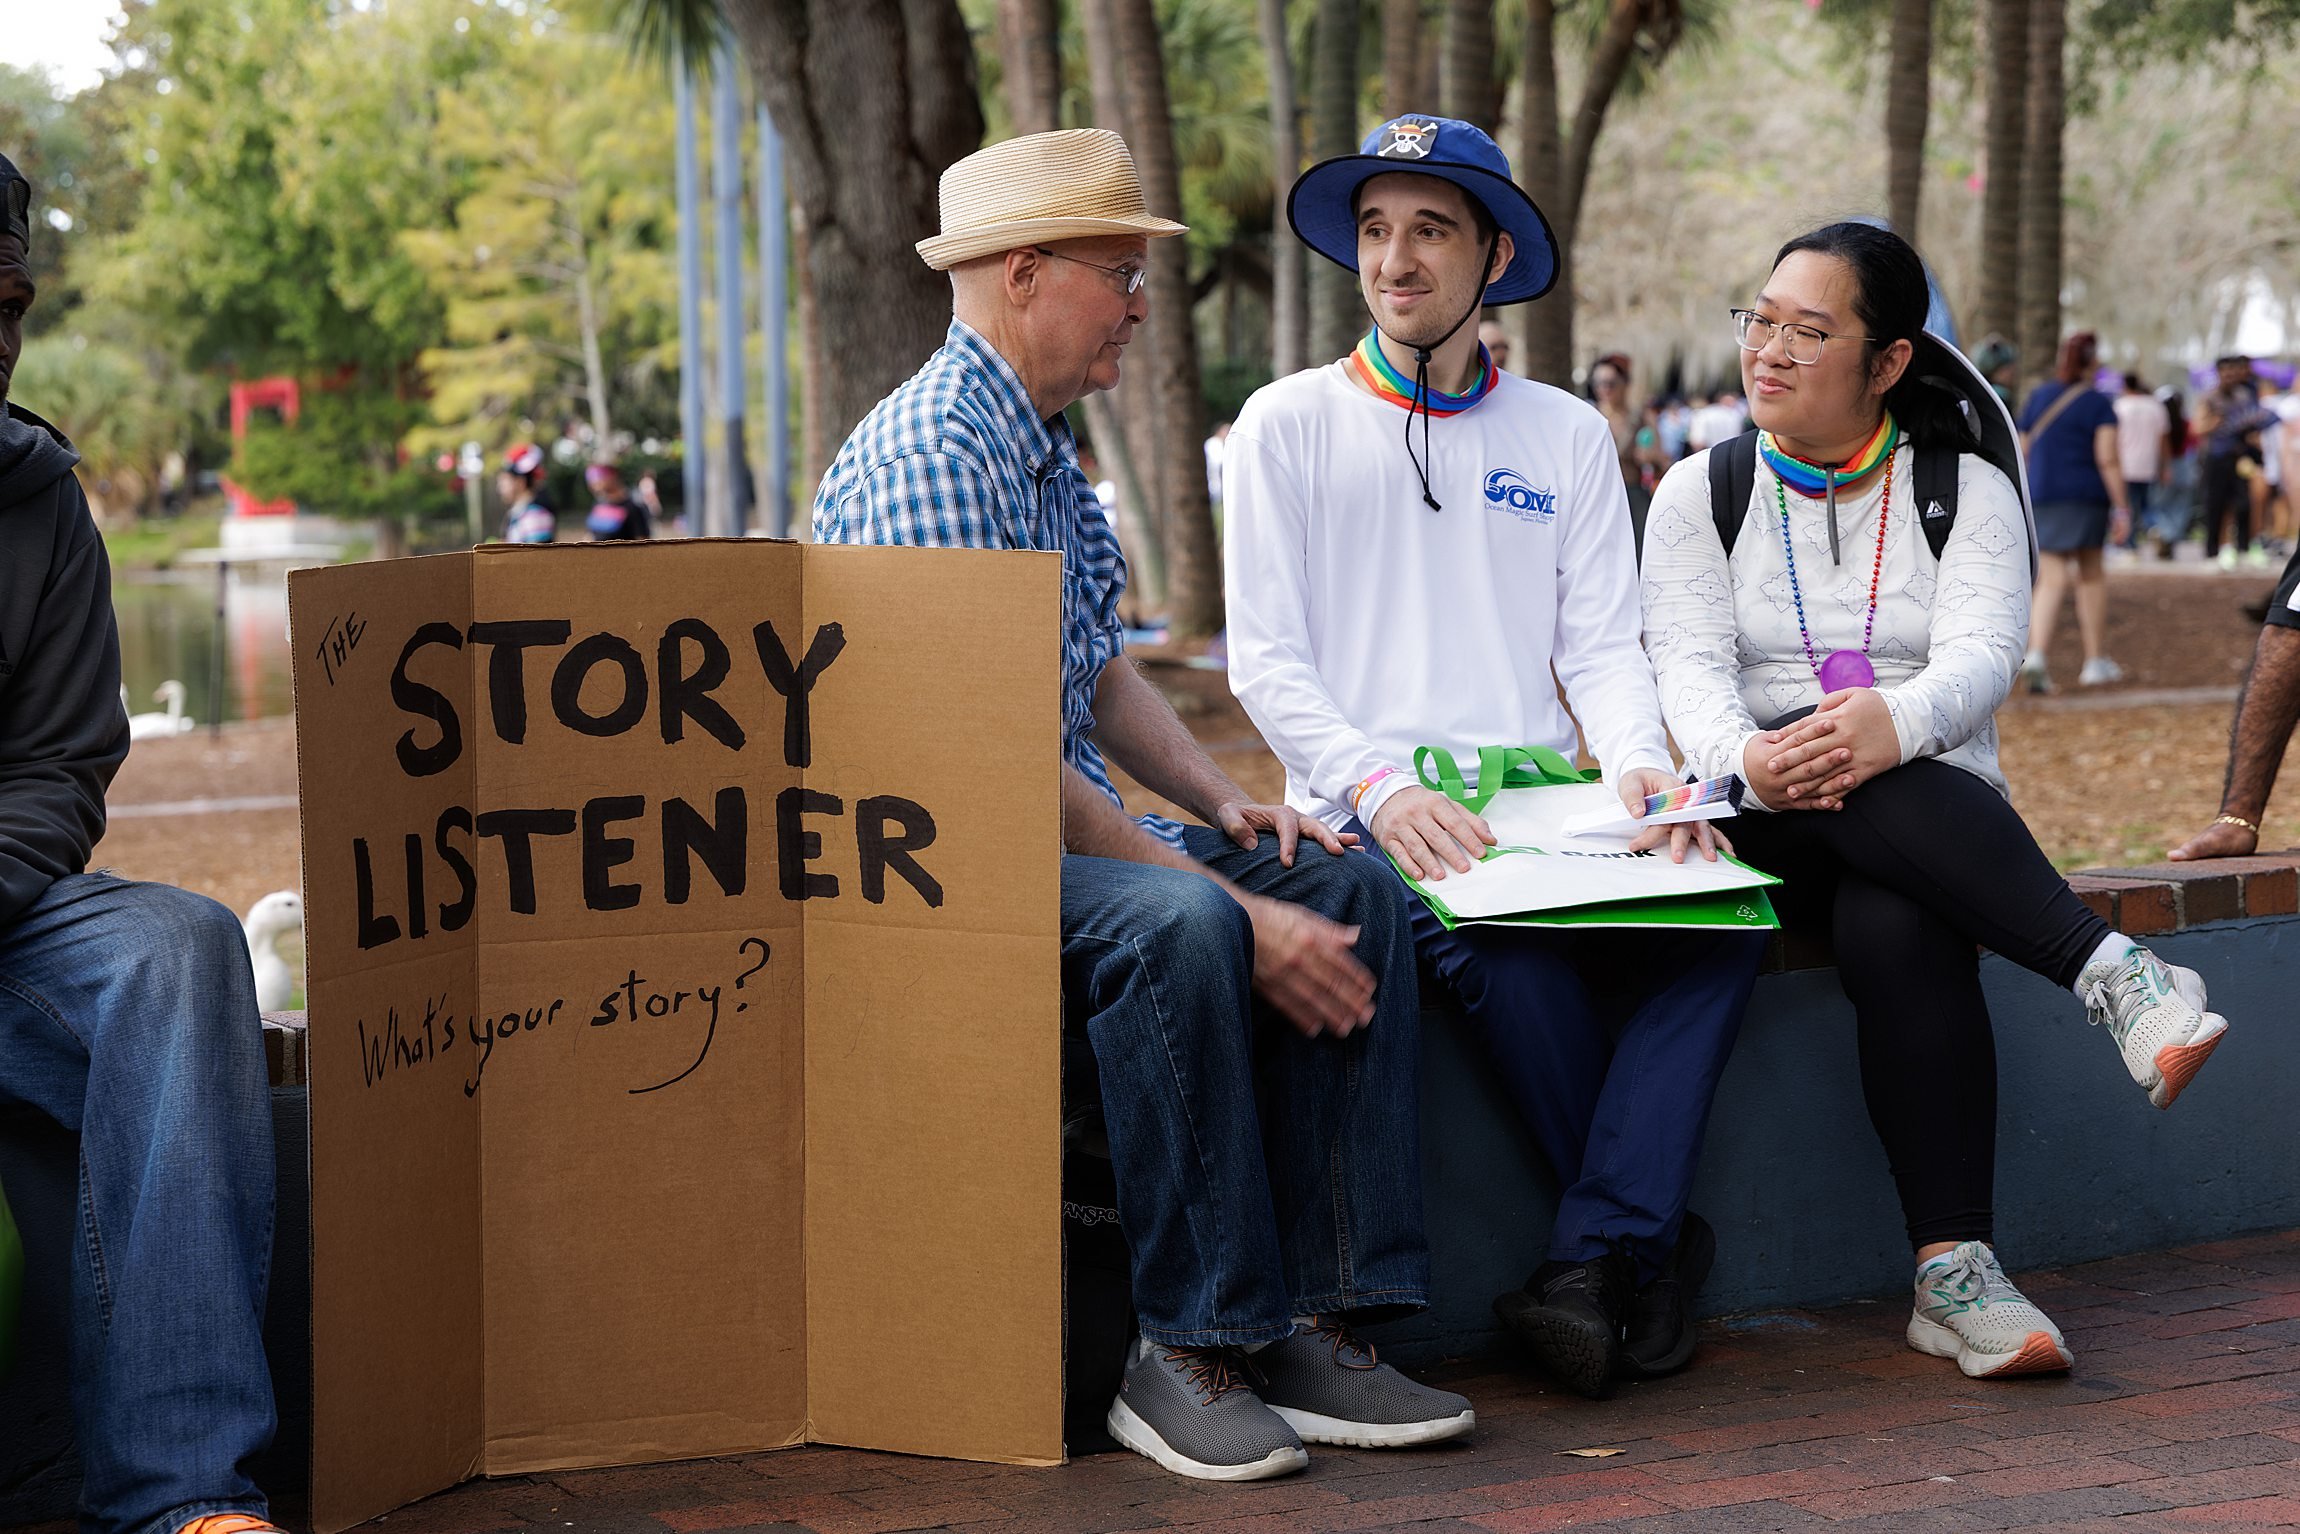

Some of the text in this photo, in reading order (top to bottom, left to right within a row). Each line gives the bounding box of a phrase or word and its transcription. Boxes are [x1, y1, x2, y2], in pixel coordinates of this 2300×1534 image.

[317, 611, 367, 687] THE
[390, 618, 847, 778] STORY
[354, 786, 944, 951] LISTENER
[358, 992, 456, 1089] What's
[463, 998, 564, 1099] your
[590, 937, 771, 1095] story?
[1062, 1200, 1121, 1227] ANSPO
